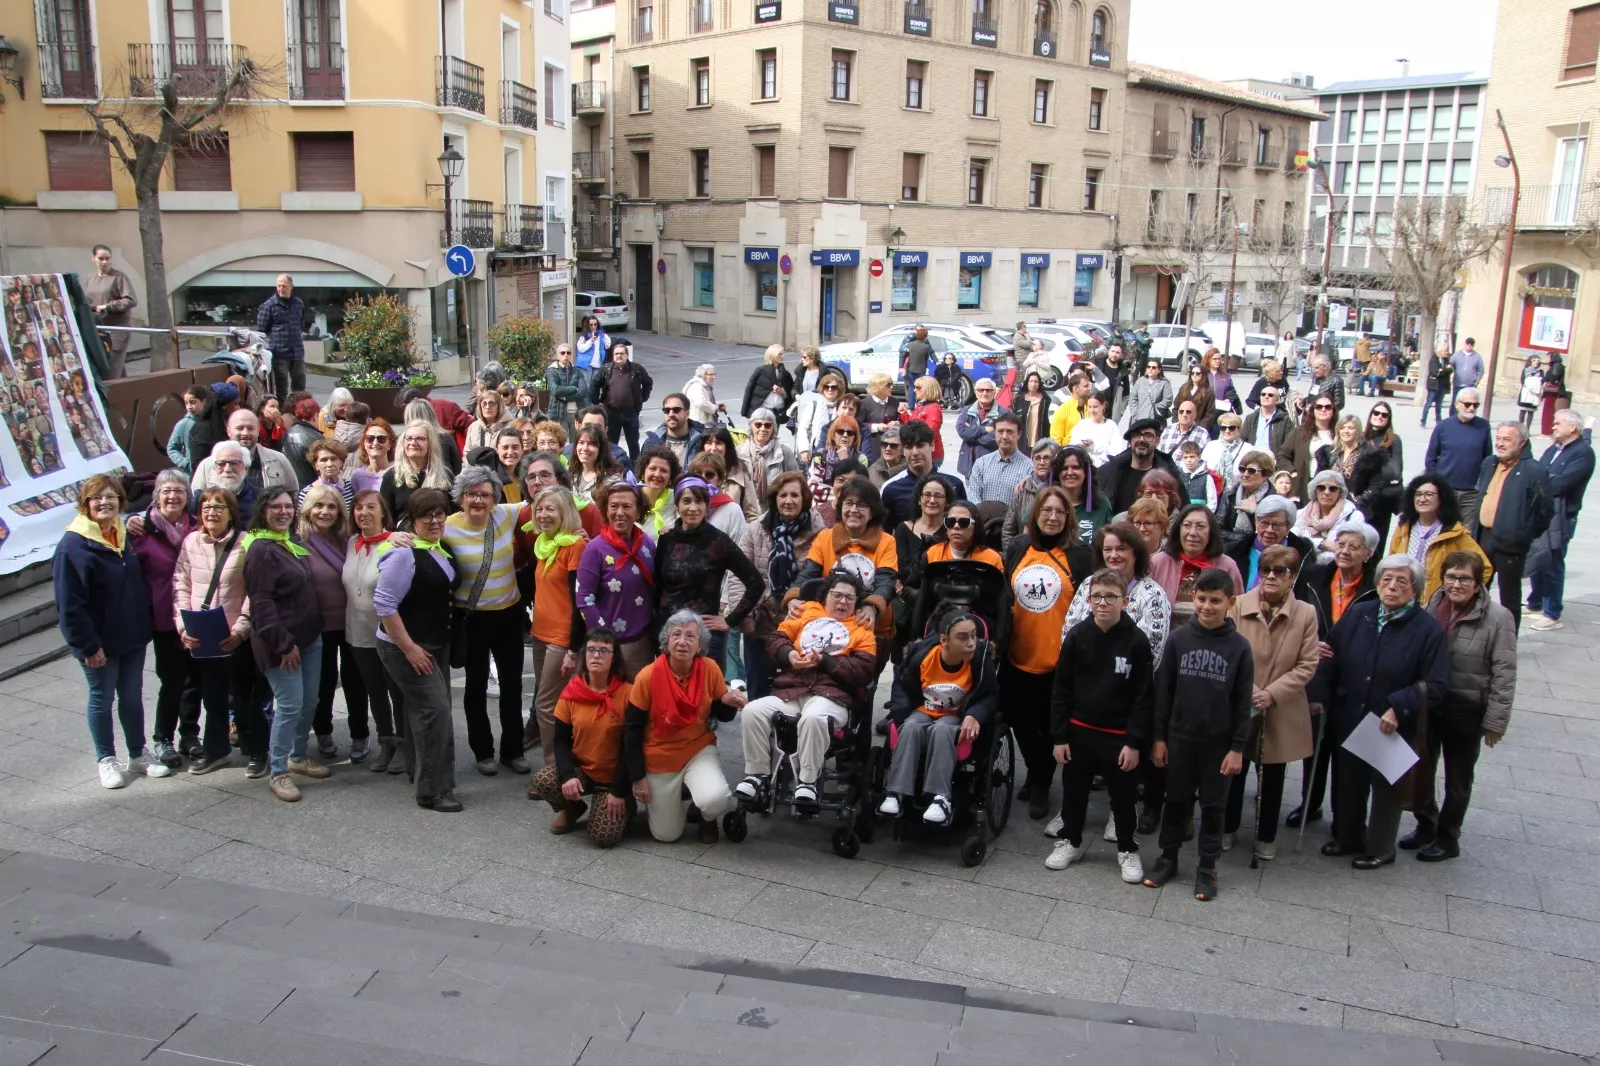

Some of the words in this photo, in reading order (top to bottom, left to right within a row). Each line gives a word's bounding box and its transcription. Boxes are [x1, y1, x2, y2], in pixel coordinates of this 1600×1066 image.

[751, 251, 770, 260] BBVA
[830, 253, 852, 262] BBVA
[901, 254, 921, 264] BBVA
[967, 255, 985, 264] BBVA
[1027, 256, 1044, 265] BBVA
[1082, 257, 1098, 265] BBVA
[1180, 649, 1229, 675] RESPECT
[1188, 669, 1198, 677] ARE
[1198, 670, 1207, 678] THE
[1207, 672, 1226, 682] FUTURE
